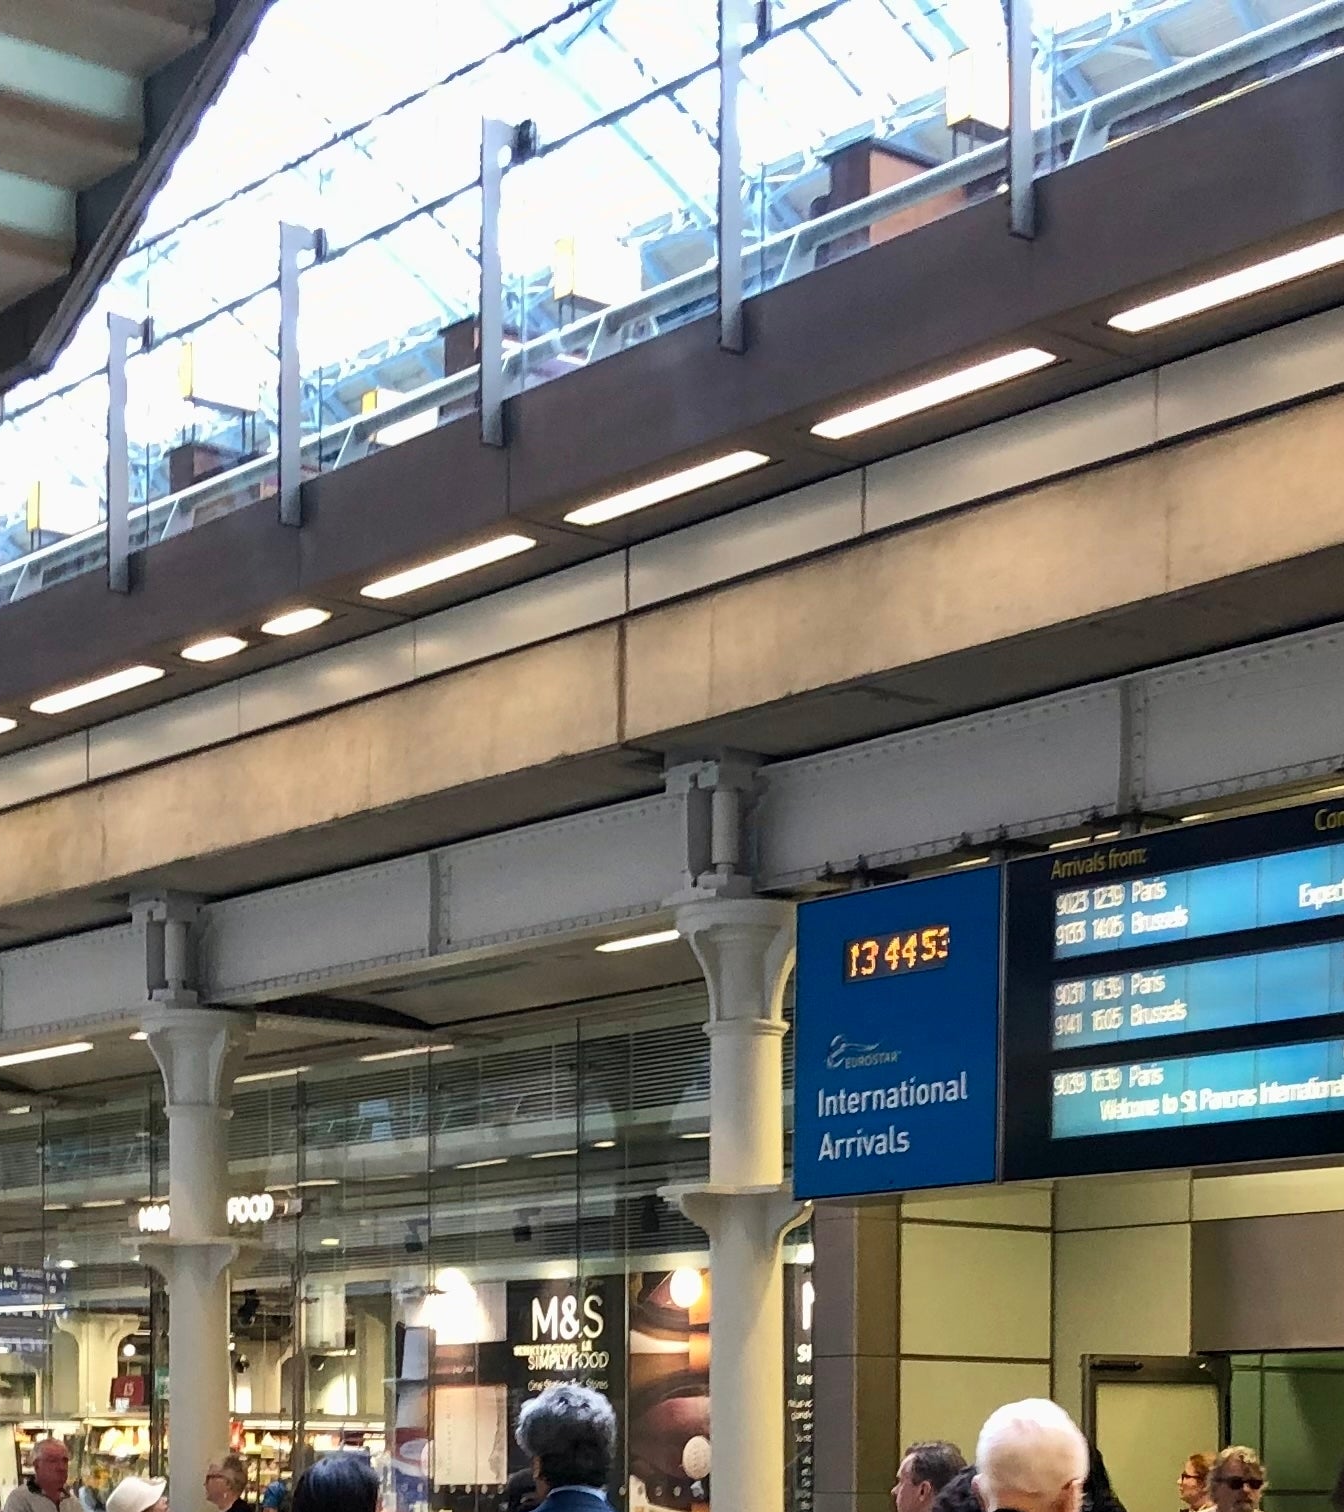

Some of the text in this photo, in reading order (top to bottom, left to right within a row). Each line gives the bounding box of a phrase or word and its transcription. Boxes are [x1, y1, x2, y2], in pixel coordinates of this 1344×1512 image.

[1050, 850, 1106, 880] Arrivals
[1131, 876, 1167, 904] Paris
[1131, 904, 1188, 935] Brussels
[1130, 970, 1166, 996] Paris
[1130, 998, 1188, 1027] Brussels
[844, 1050, 899, 1070] EUROSTAR
[1129, 1062, 1165, 1089] Paris
[818, 1071, 968, 1118] International
[1100, 1097, 1159, 1121] Welcome
[1162, 1094, 1178, 1114] to
[1199, 1087, 1257, 1111] Pancras
[818, 1125, 911, 1162] Arrivals
[226, 1193, 274, 1225] FOOD
[531, 1294, 604, 1342] M&S
[527, 1350, 610, 1372] SIMPLY FOOD
